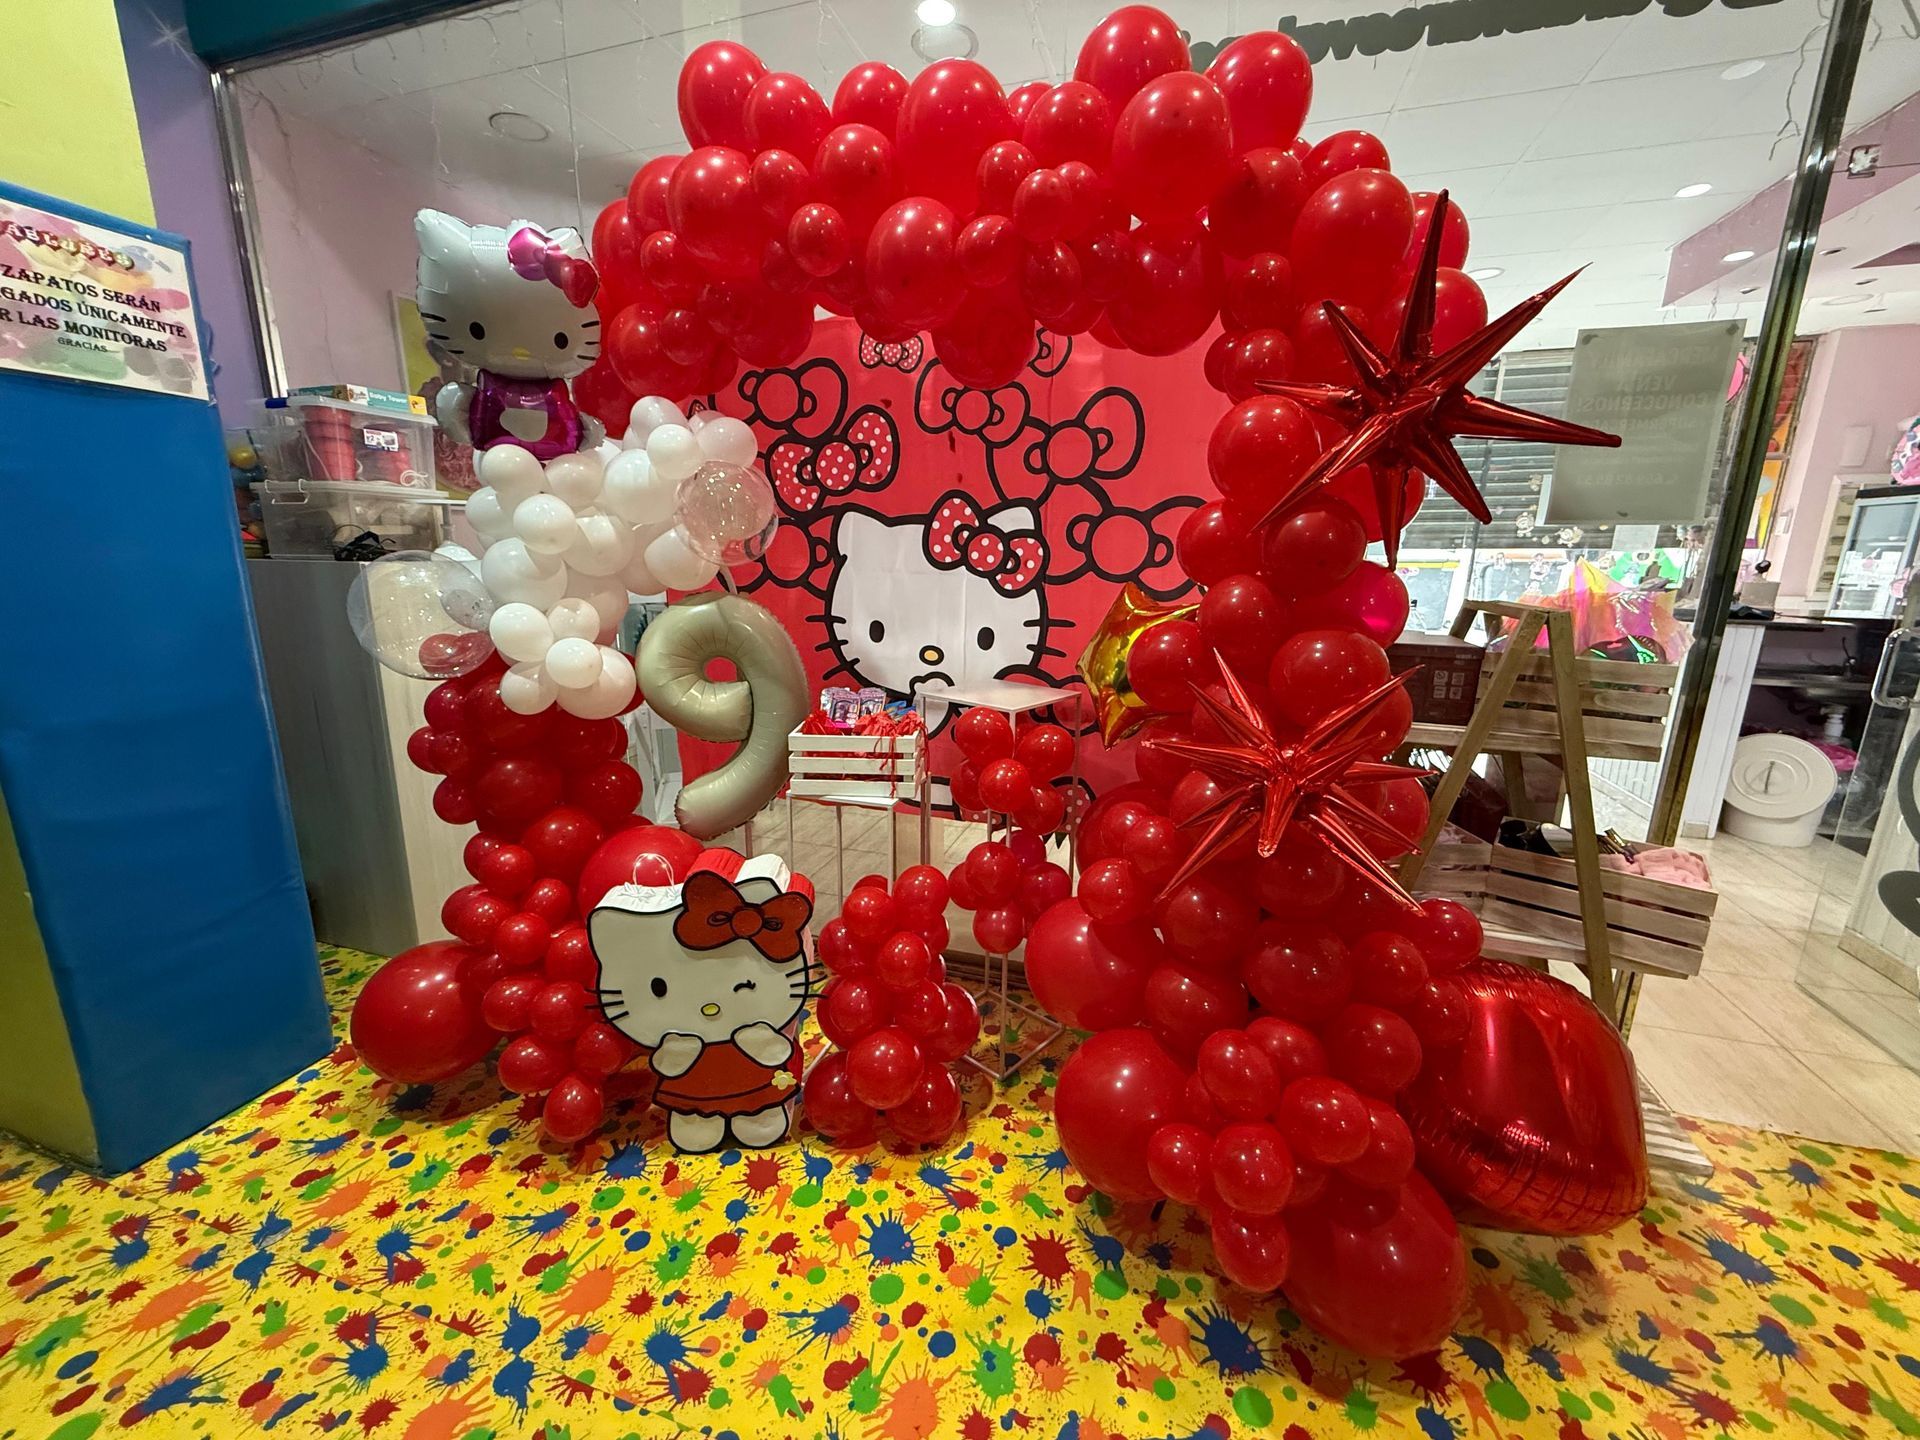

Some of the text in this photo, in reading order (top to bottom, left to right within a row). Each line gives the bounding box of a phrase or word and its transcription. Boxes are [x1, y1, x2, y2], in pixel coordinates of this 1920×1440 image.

[0, 263, 161, 314] ZAPATOS SERÁN
[0, 286, 187, 339] GADOS ÚNICAMENTE
[17, 310, 60, 330] LAS
[64, 320, 168, 352] MONITORAS
[57, 337, 109, 353] GRACIAS
[635, 589, 811, 841] 9
